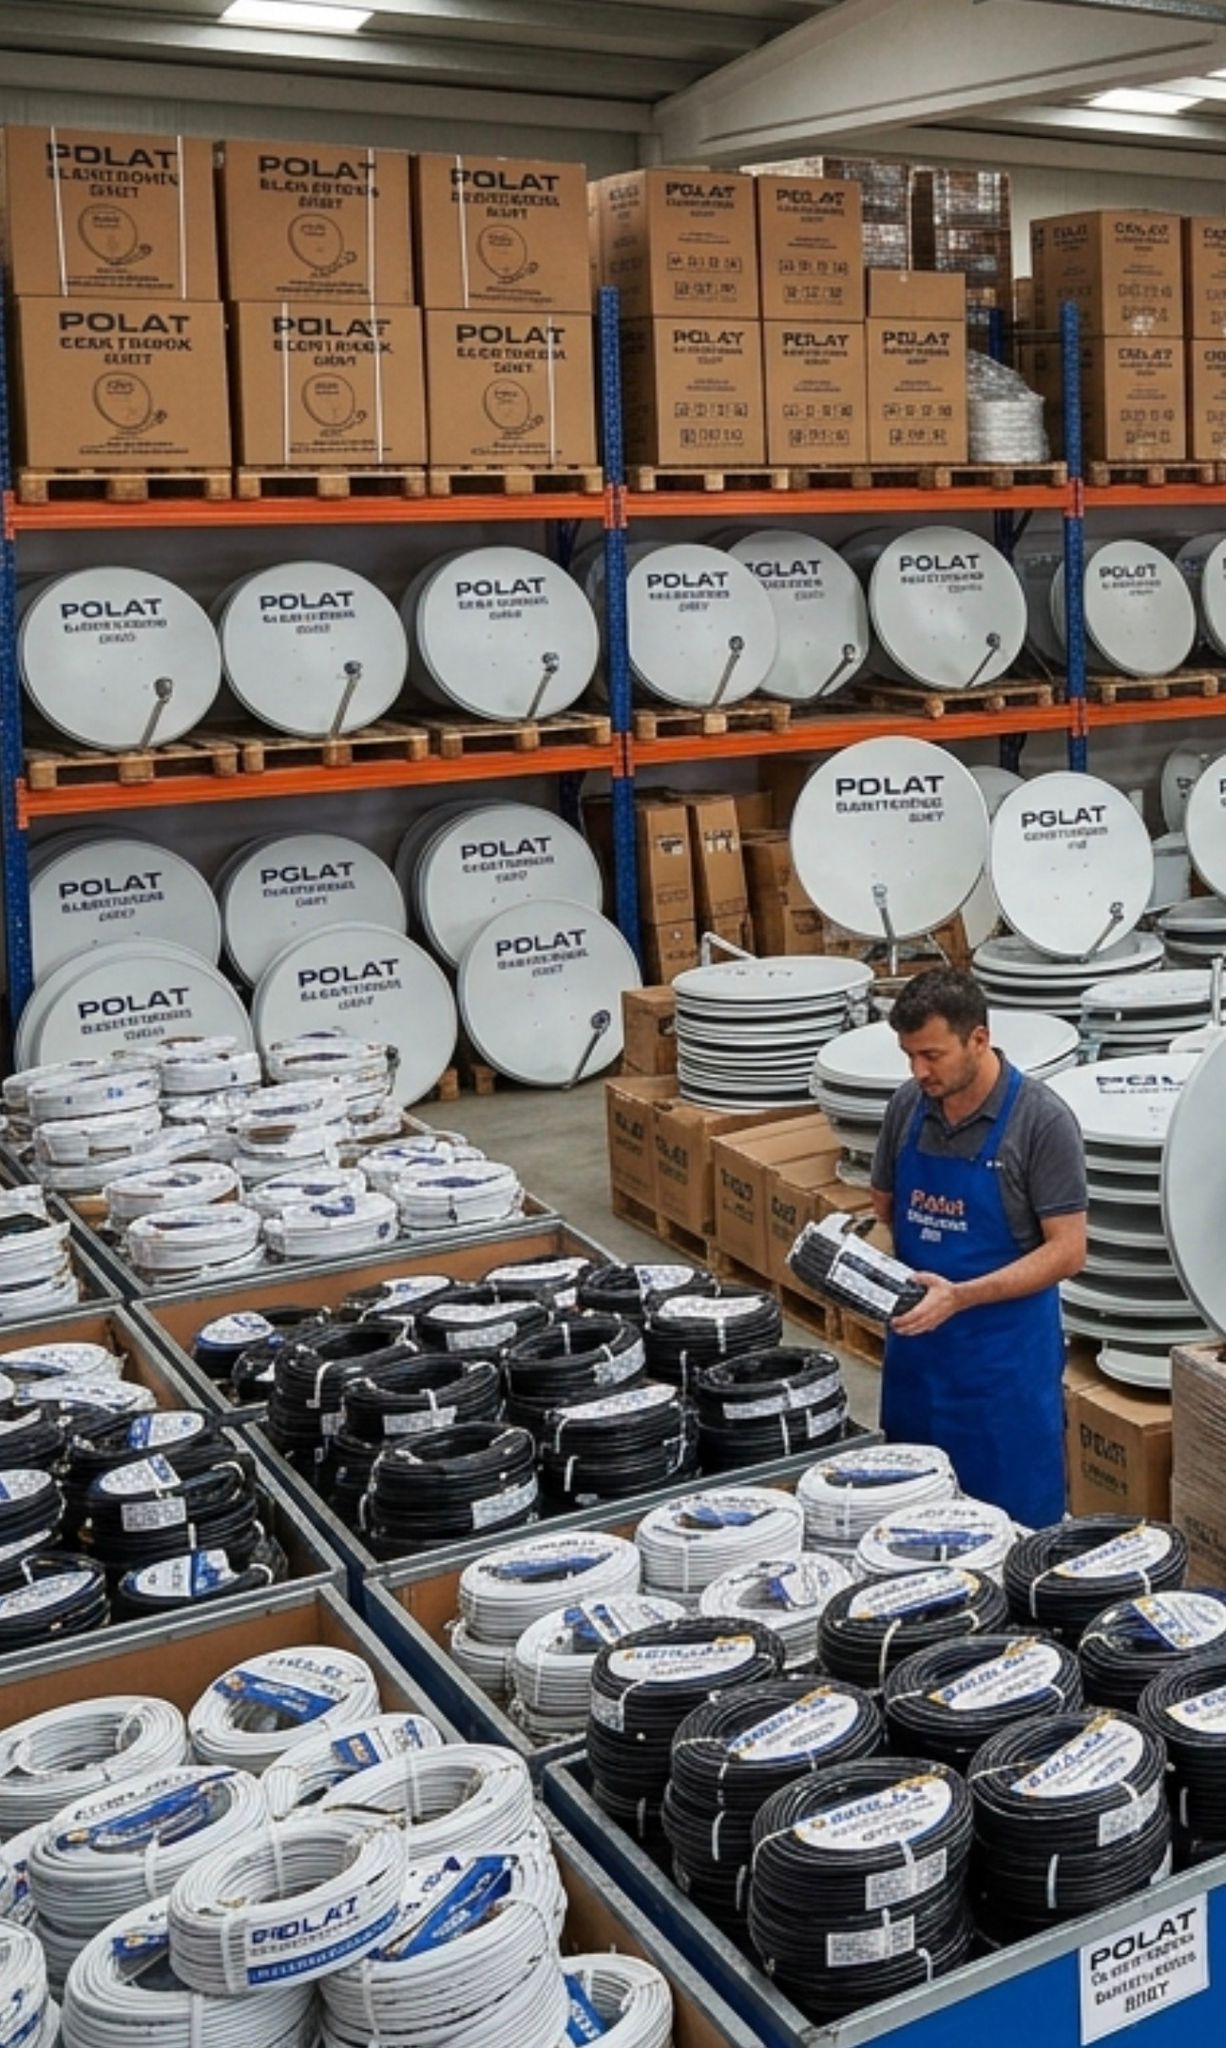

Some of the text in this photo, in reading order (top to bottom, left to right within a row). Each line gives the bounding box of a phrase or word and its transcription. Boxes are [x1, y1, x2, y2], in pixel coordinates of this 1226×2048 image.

[46, 143, 178, 169] POLAT
[258, 155, 376, 180] POLAT
[450, 168, 560, 192] POLAT
[59, 312, 190, 334] POLAT
[456, 324, 566, 344] POLAT
[900, 553, 980, 572] POLAT
[455, 577, 546, 597] POLAT
[646, 571, 729, 589] POLAT
[60, 598, 162, 619] POLAT
[259, 591, 355, 611] POLAT
[58, 872, 162, 899] POLAT
[298, 958, 399, 988] POLAT
[78, 987, 190, 1019] POLAT
[1090, 1907, 1197, 1972] POLAT
